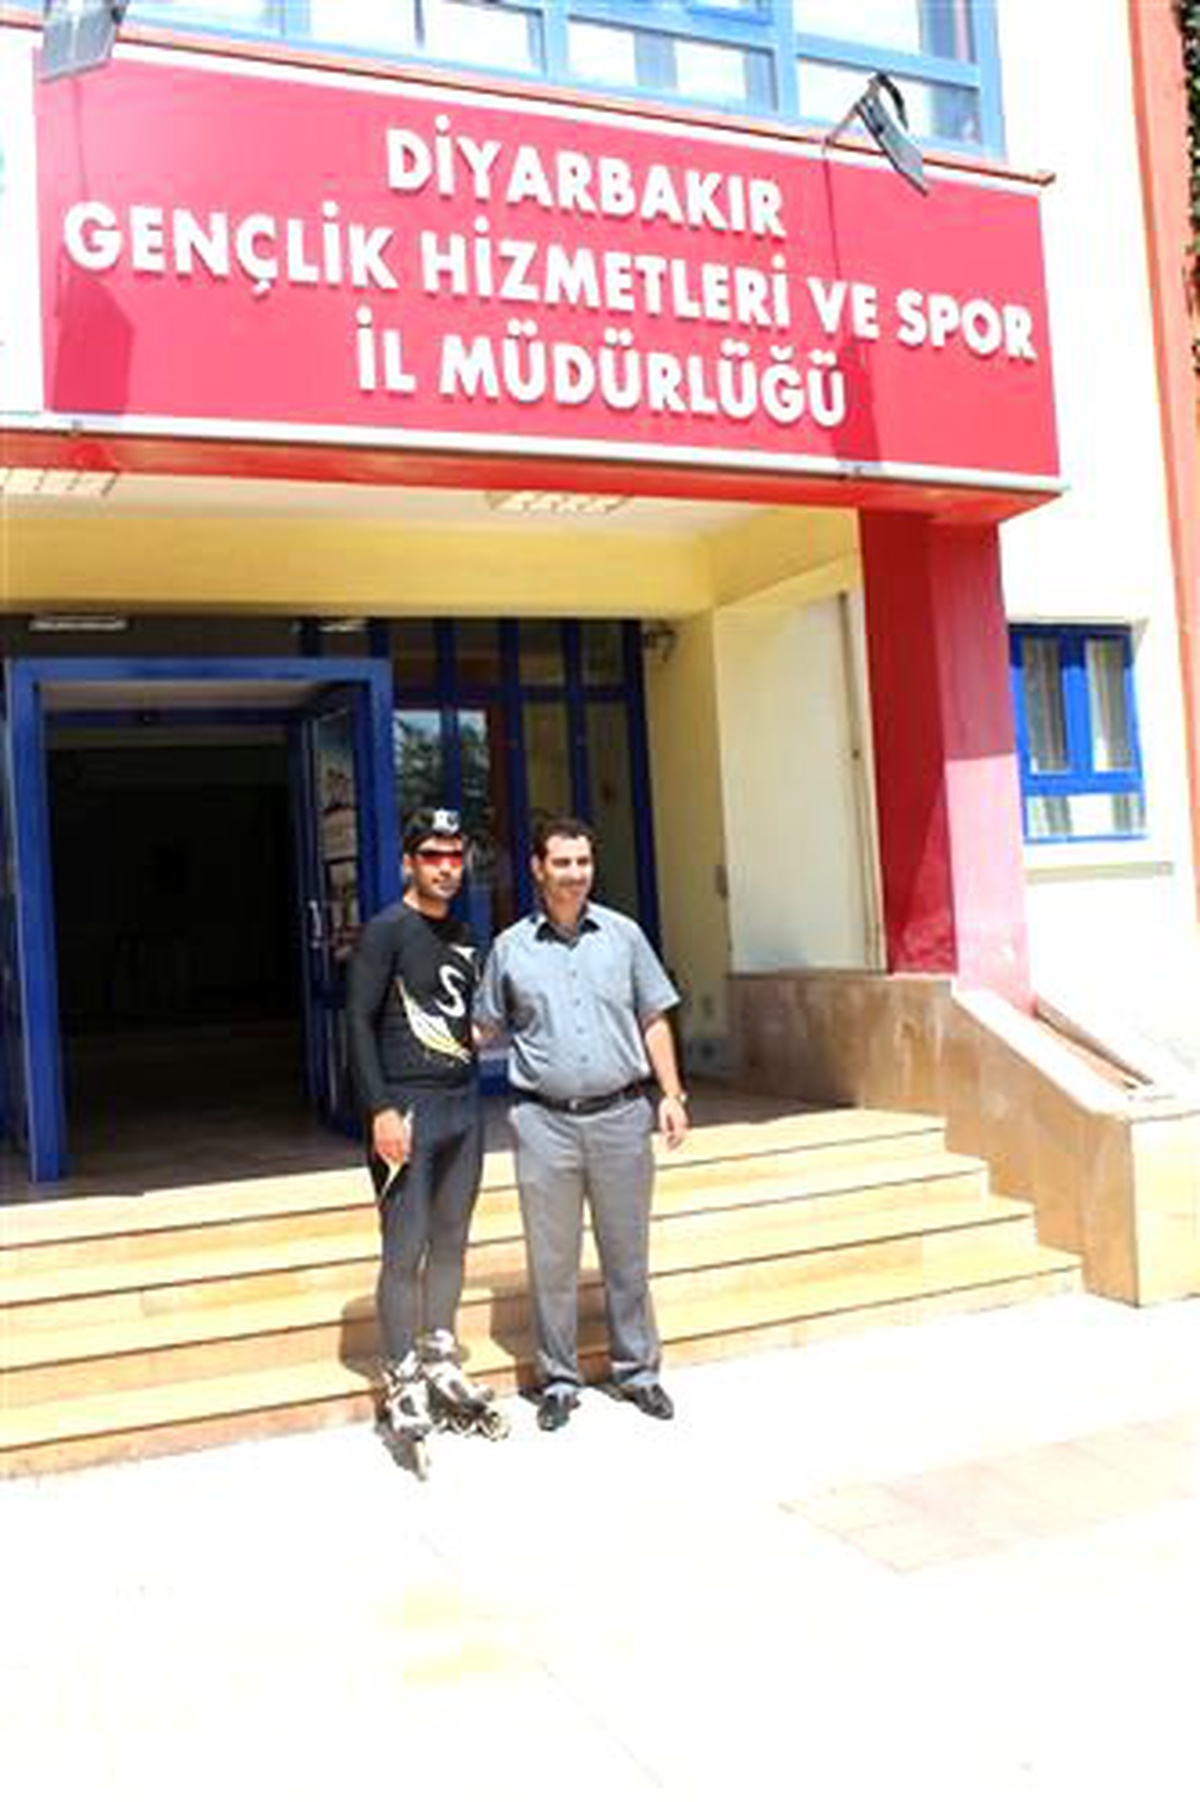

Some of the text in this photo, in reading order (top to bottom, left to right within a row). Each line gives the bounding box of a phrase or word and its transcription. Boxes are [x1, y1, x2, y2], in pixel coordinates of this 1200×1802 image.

[385, 114, 787, 239] DİYARBAKIR
[64, 201, 1037, 361] GENÇLİK HİZMETLERİ VE SPOR
[356, 305, 847, 428] İL MÜDÜRLÜĞÜ
